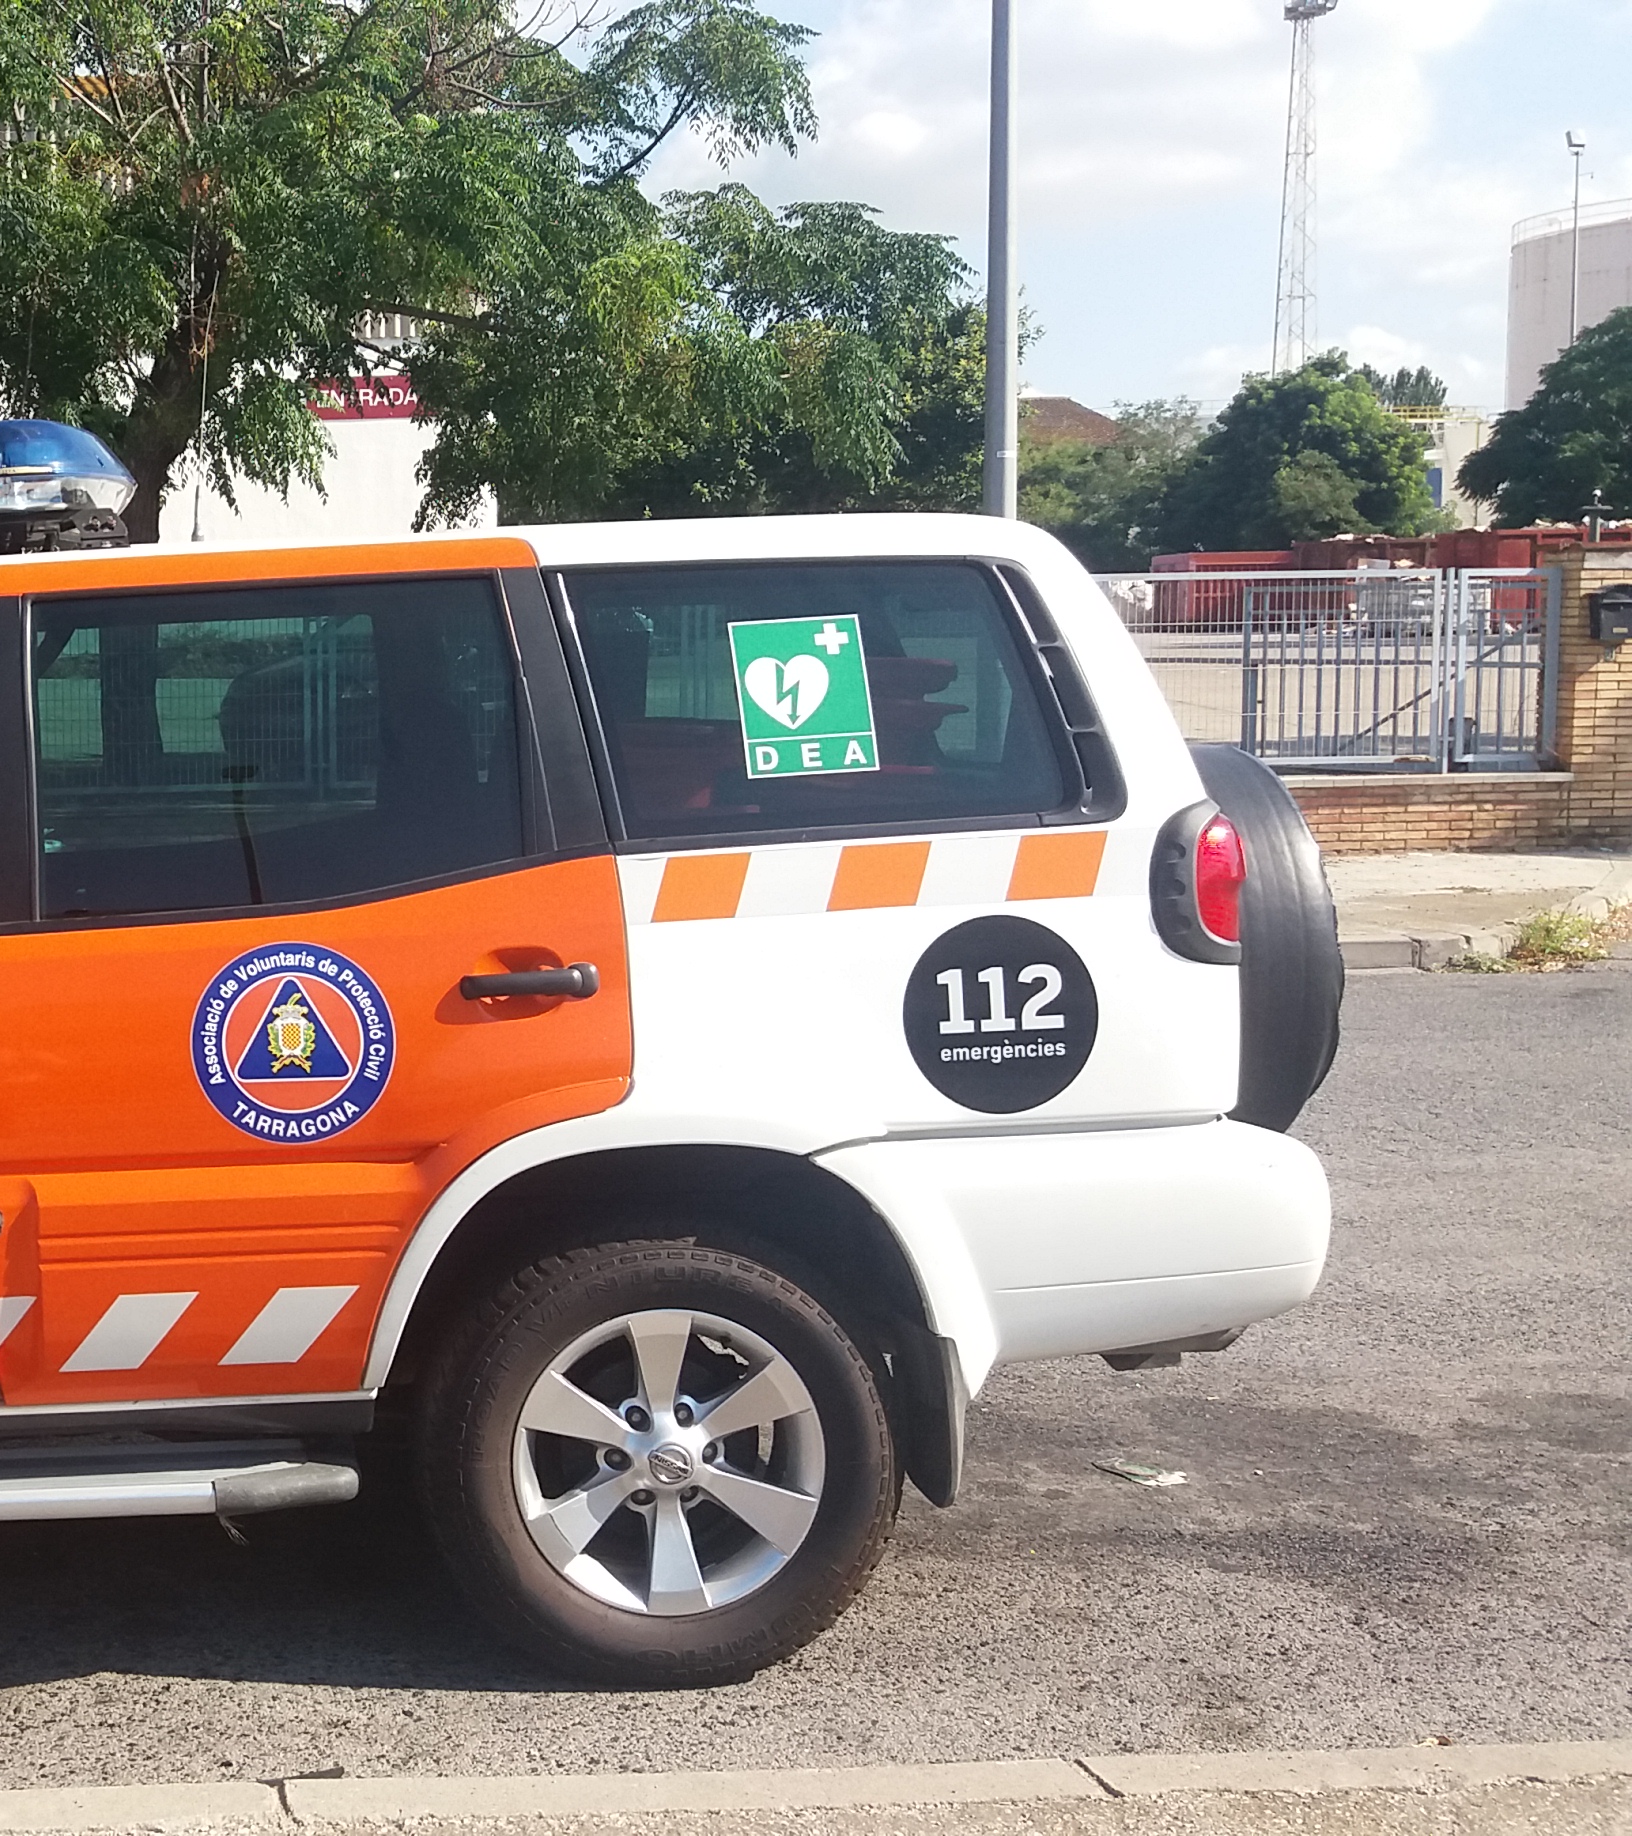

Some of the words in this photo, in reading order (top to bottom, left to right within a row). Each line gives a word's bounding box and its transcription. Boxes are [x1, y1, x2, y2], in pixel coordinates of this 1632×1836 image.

[201, 997, 226, 1085] Associació
[219, 978, 239, 999] de
[234, 951, 315, 982] Voluntaris
[318, 958, 338, 976] de
[338, 969, 386, 1040] Protecció
[363, 1043, 386, 1081] Civil
[936, 963, 1065, 1034] 112
[940, 1038, 1066, 1064] emergències
[232, 1100, 360, 1137] TARRAGONA
